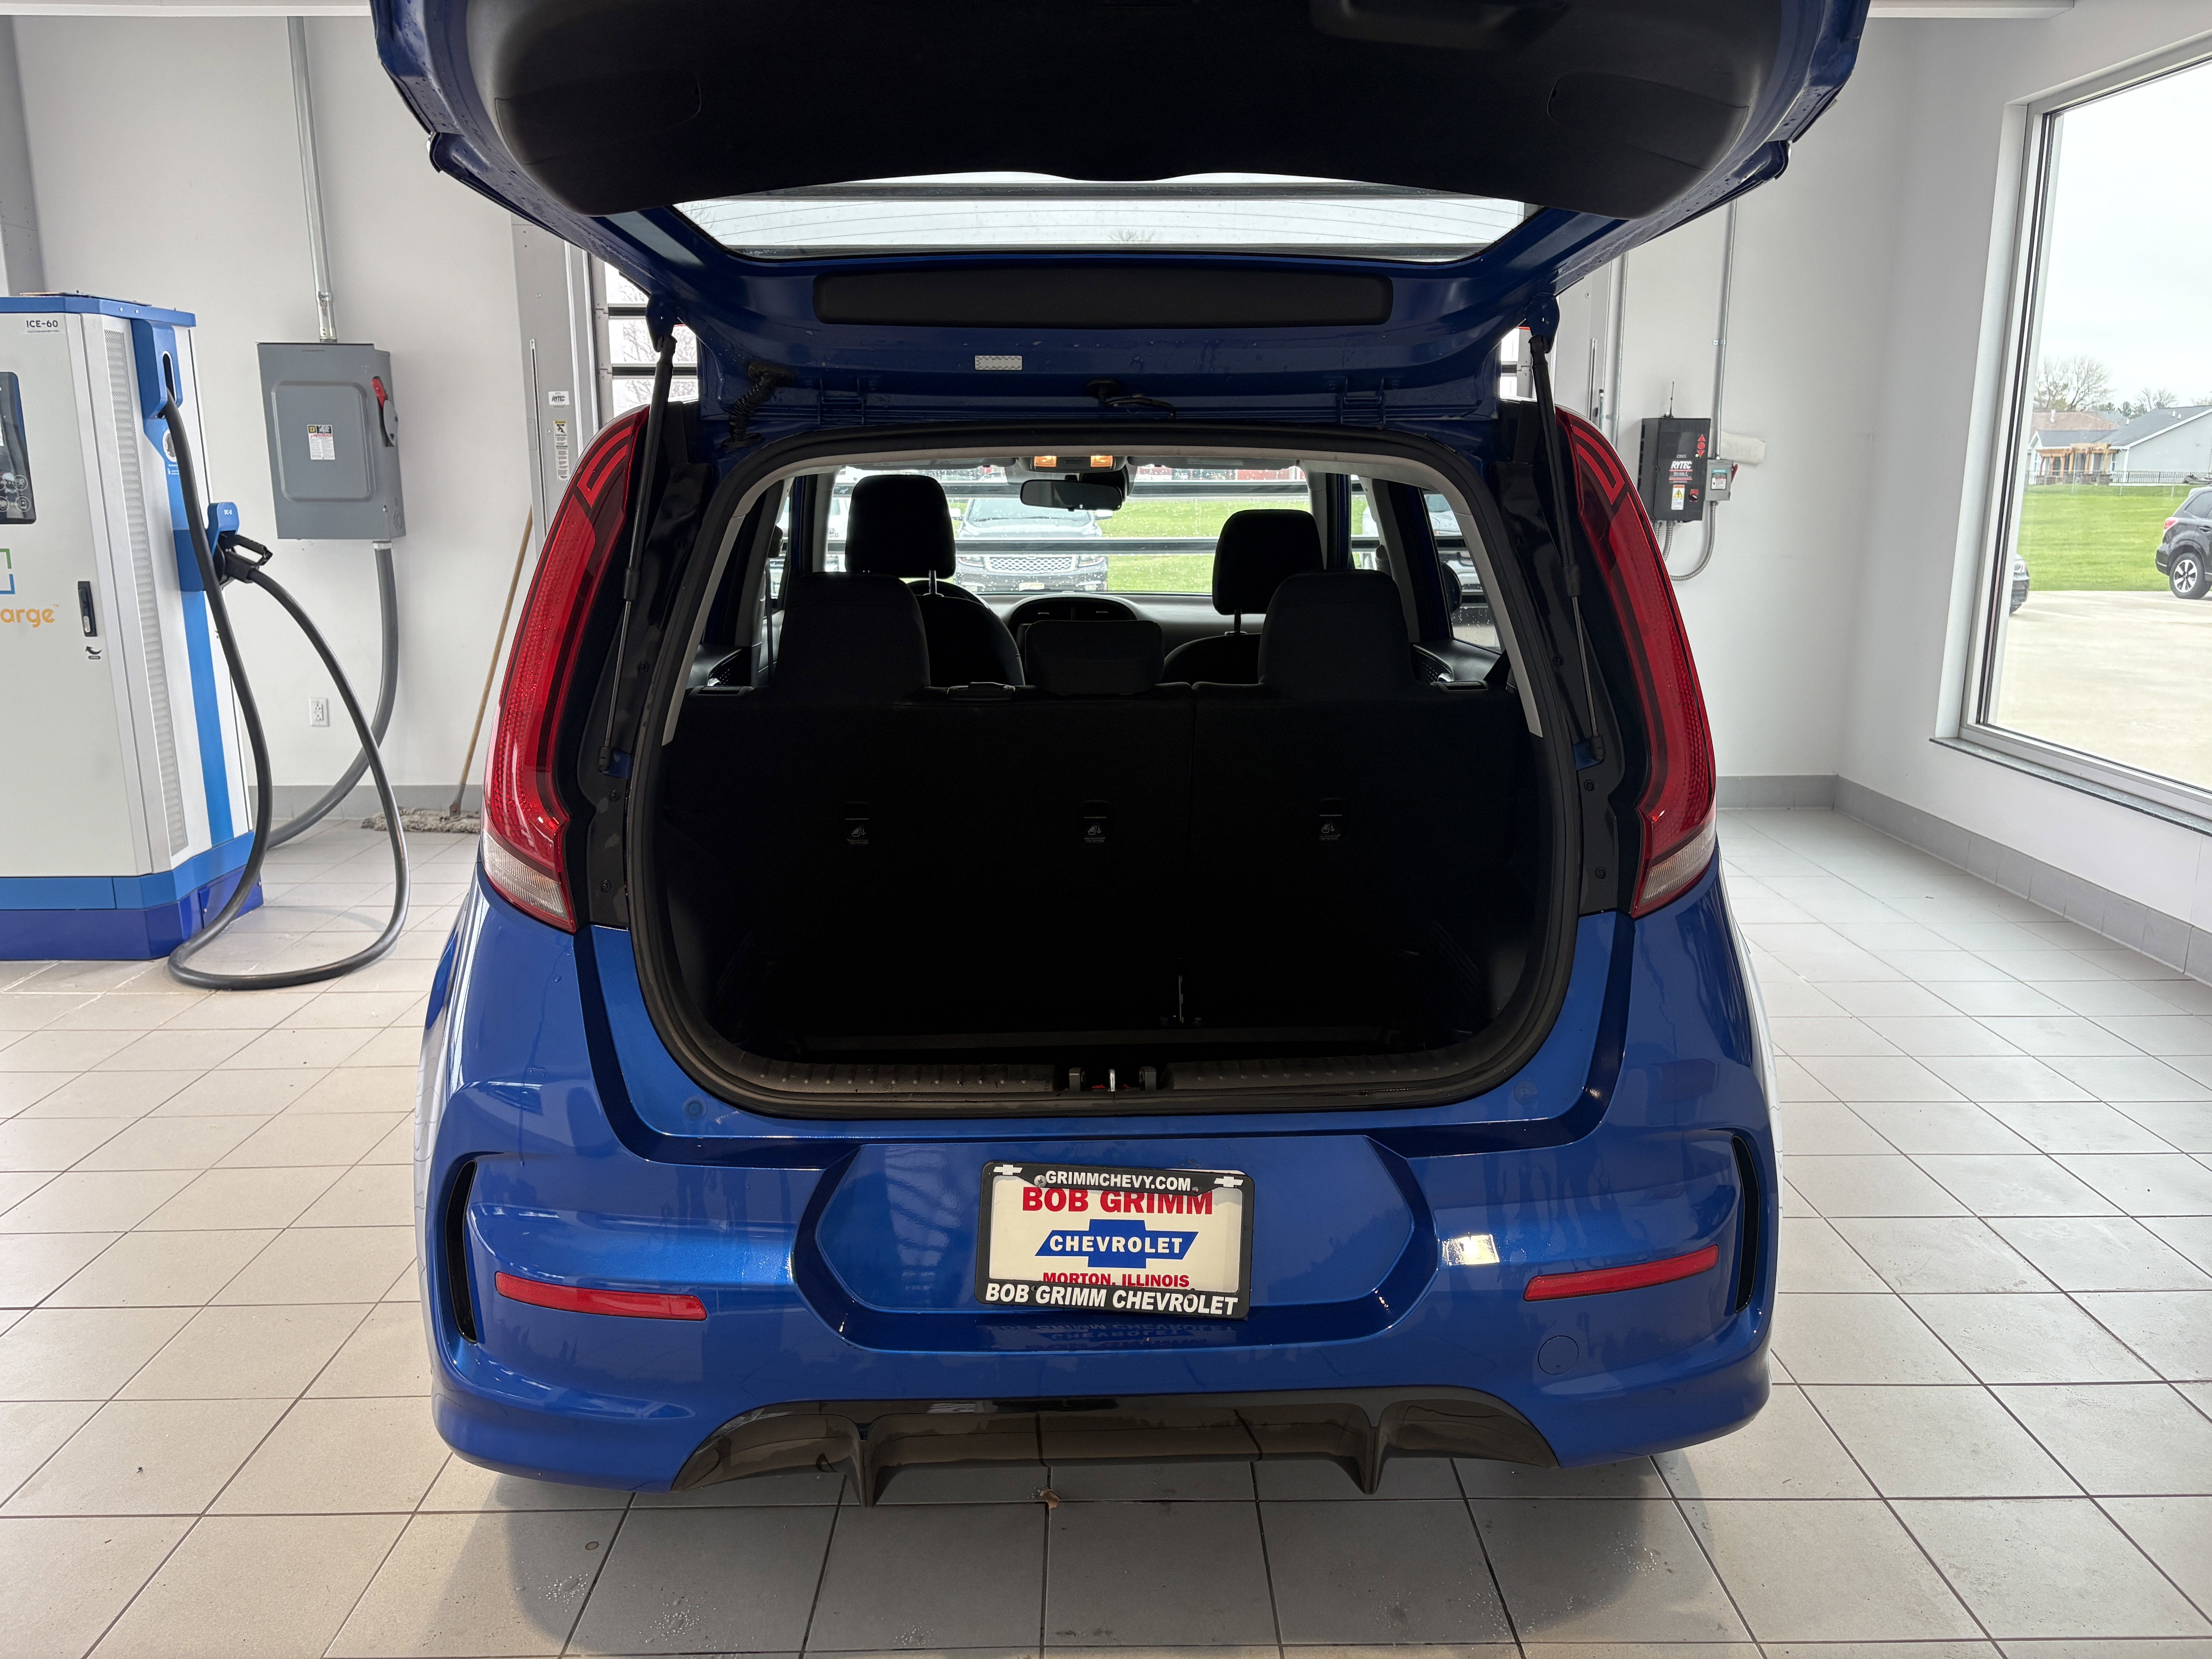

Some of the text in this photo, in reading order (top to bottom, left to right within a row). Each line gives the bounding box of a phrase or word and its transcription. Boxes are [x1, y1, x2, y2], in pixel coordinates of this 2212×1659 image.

[1671, 461, 1692, 469] RYTEC
[1046, 1170, 1191, 1191] GRIMMCHEVY.COM
[1023, 1187, 1212, 1214] BOB GRIMM
[1049, 1235, 1182, 1253] CHEVROLET
[1122, 1274, 1190, 1287] ILLINOIS
[985, 1283, 1238, 1315] BOB GRIMM CHEVROLET
